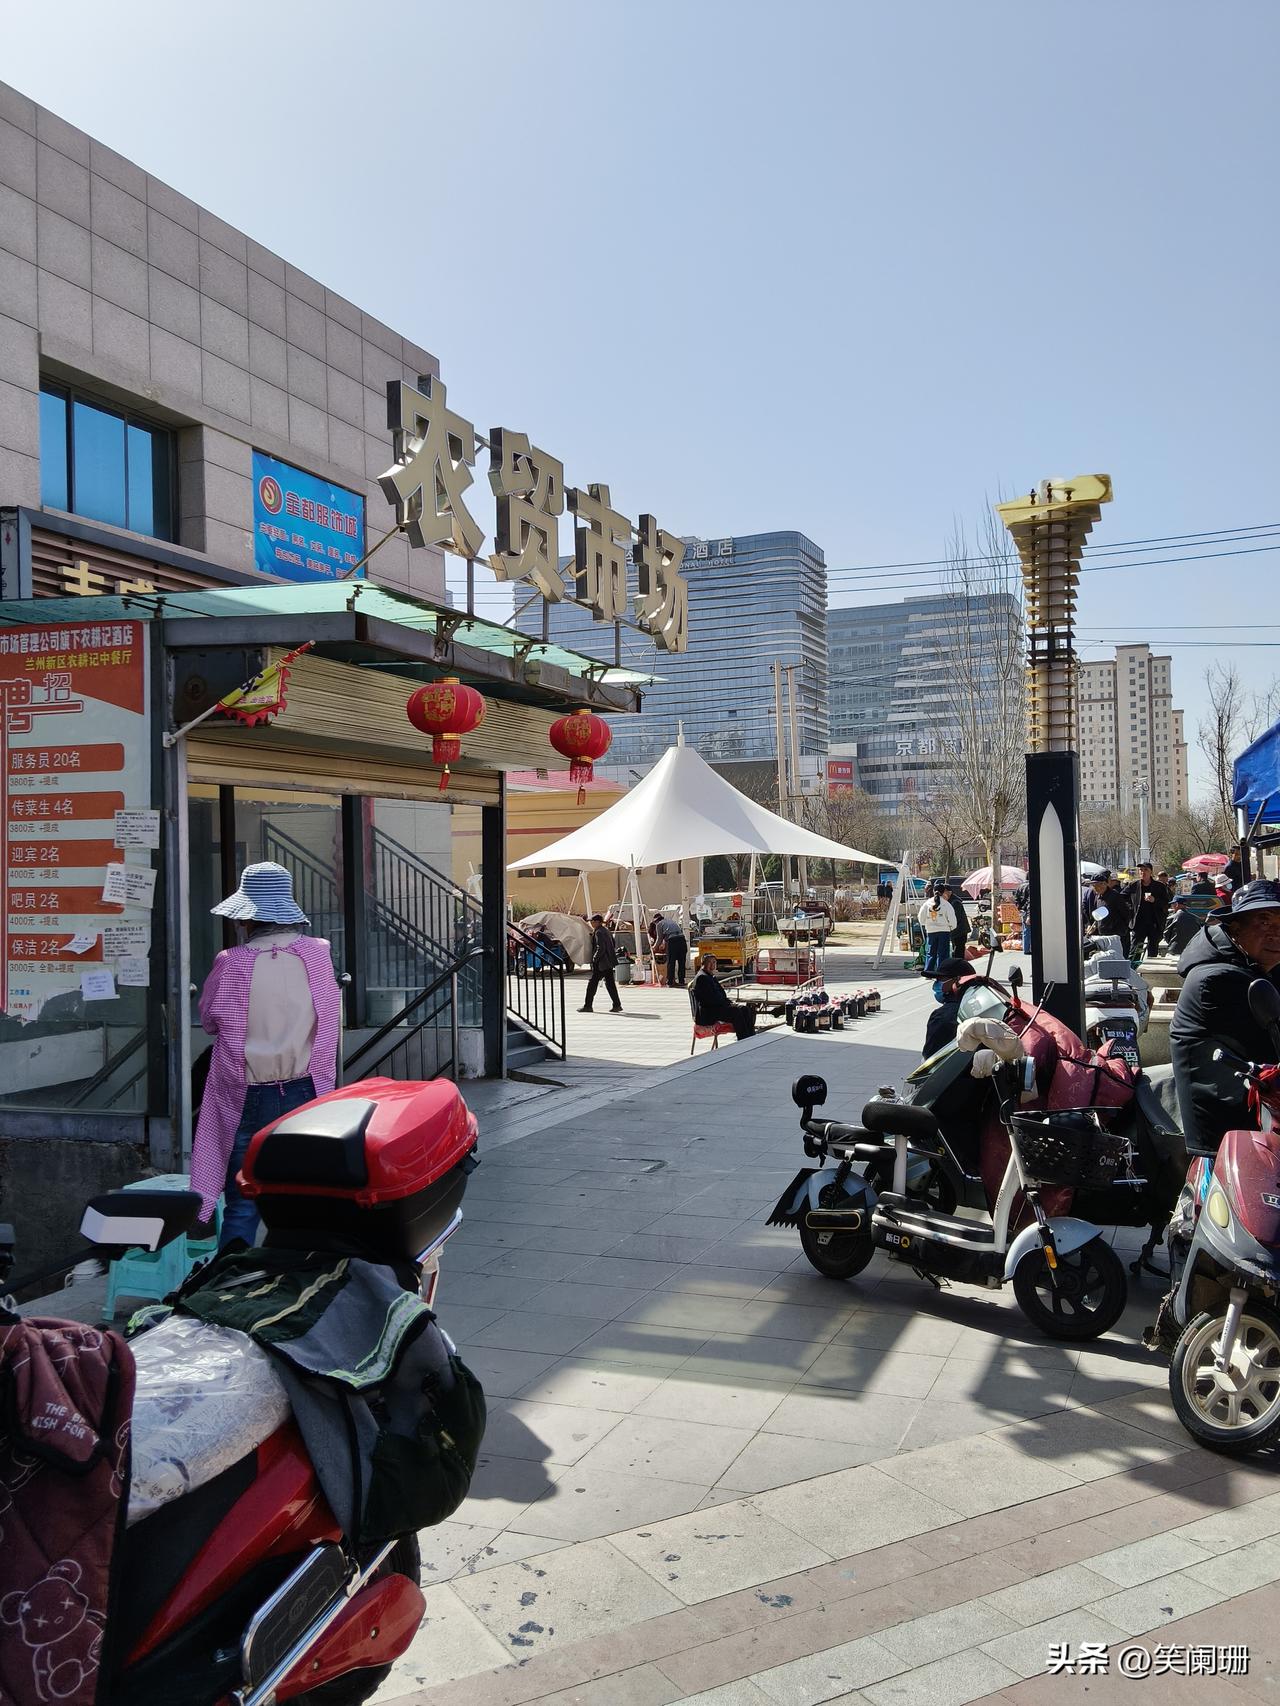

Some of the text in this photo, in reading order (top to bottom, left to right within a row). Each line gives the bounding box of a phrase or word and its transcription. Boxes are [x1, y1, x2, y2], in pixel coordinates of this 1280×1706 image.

[377, 374, 688, 653] 农贸市场
[25, 650, 132, 671] 兰州新区农耕记中餐厅
[43, 672, 72, 703] 招
[12, 751, 81, 769] 服务员 20名
[12, 798, 74, 816] 传菜生 4名
[9, 823, 60, 833] 3800元 +提成
[12, 846, 60, 862] 迎宾 2名
[9, 869, 60, 879] 4000元 +提成
[12, 893, 60, 909] 吧员 2名
[9, 916, 60, 926] 4000元 +提成
[12, 940, 38, 955] 保洁
[40, 940, 60, 955] 2名
[9, 963, 35, 973] 3000元
[46, 1403, 68, 1417] THE
[62, 1421, 86, 1440] FOR
